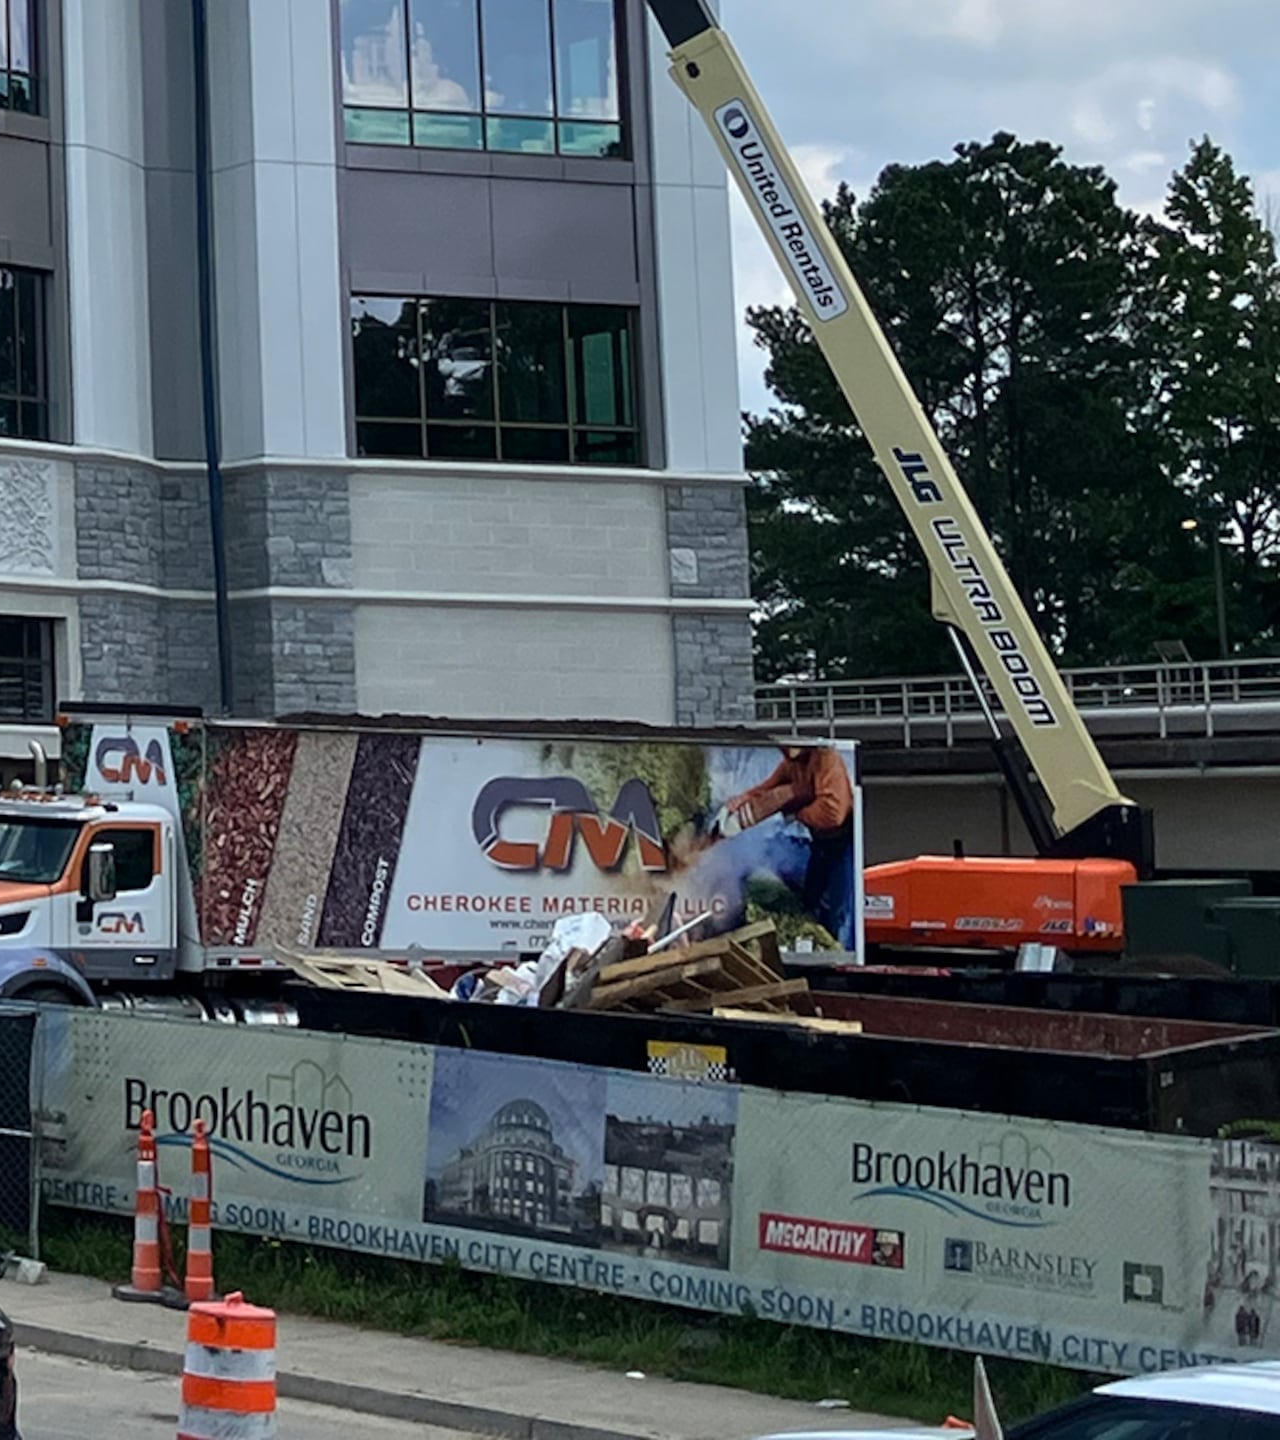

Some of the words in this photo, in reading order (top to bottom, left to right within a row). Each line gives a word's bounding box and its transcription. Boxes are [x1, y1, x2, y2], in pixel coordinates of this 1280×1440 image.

[740, 141, 791, 218] United
[780, 221, 834, 308] Rentals
[893, 447, 942, 503] JLG
[932, 517, 1003, 622] ULTRA
[988, 629, 1057, 727] BOOM
[96, 737, 167, 786] CM
[472, 776, 668, 871] CM
[97, 912, 145, 933] CM
[233, 878, 258, 945] MULCH
[297, 893, 318, 946] SAND
[361, 855, 389, 946] COMPOST
[406, 894, 533, 913] CHEROKEE
[542, 896, 653, 914] MATERIA
[684, 897, 726, 915] LLC
[1041, 920, 1072, 932] JLG
[124, 1077, 371, 1159] Brookhaven
[276, 1152, 341, 1175] GEORGIA
[852, 1143, 1070, 1208] Brookhaven
[225, 1203, 287, 1232] SOON
[308, 1215, 460, 1259] BROOKHAVEN
[468, 1241, 522, 1269] CITY
[529, 1251, 625, 1288] CENTRE
[649, 1270, 752, 1308] COMING
[760, 1288, 834, 1324] SOON
[860, 1304, 1052, 1358] BROOKHAVEN
[1062, 1334, 1129, 1368] CITY
[1139, 1346, 1238, 1372] CENT
[975, 1240, 1097, 1279] BARNSLEY
